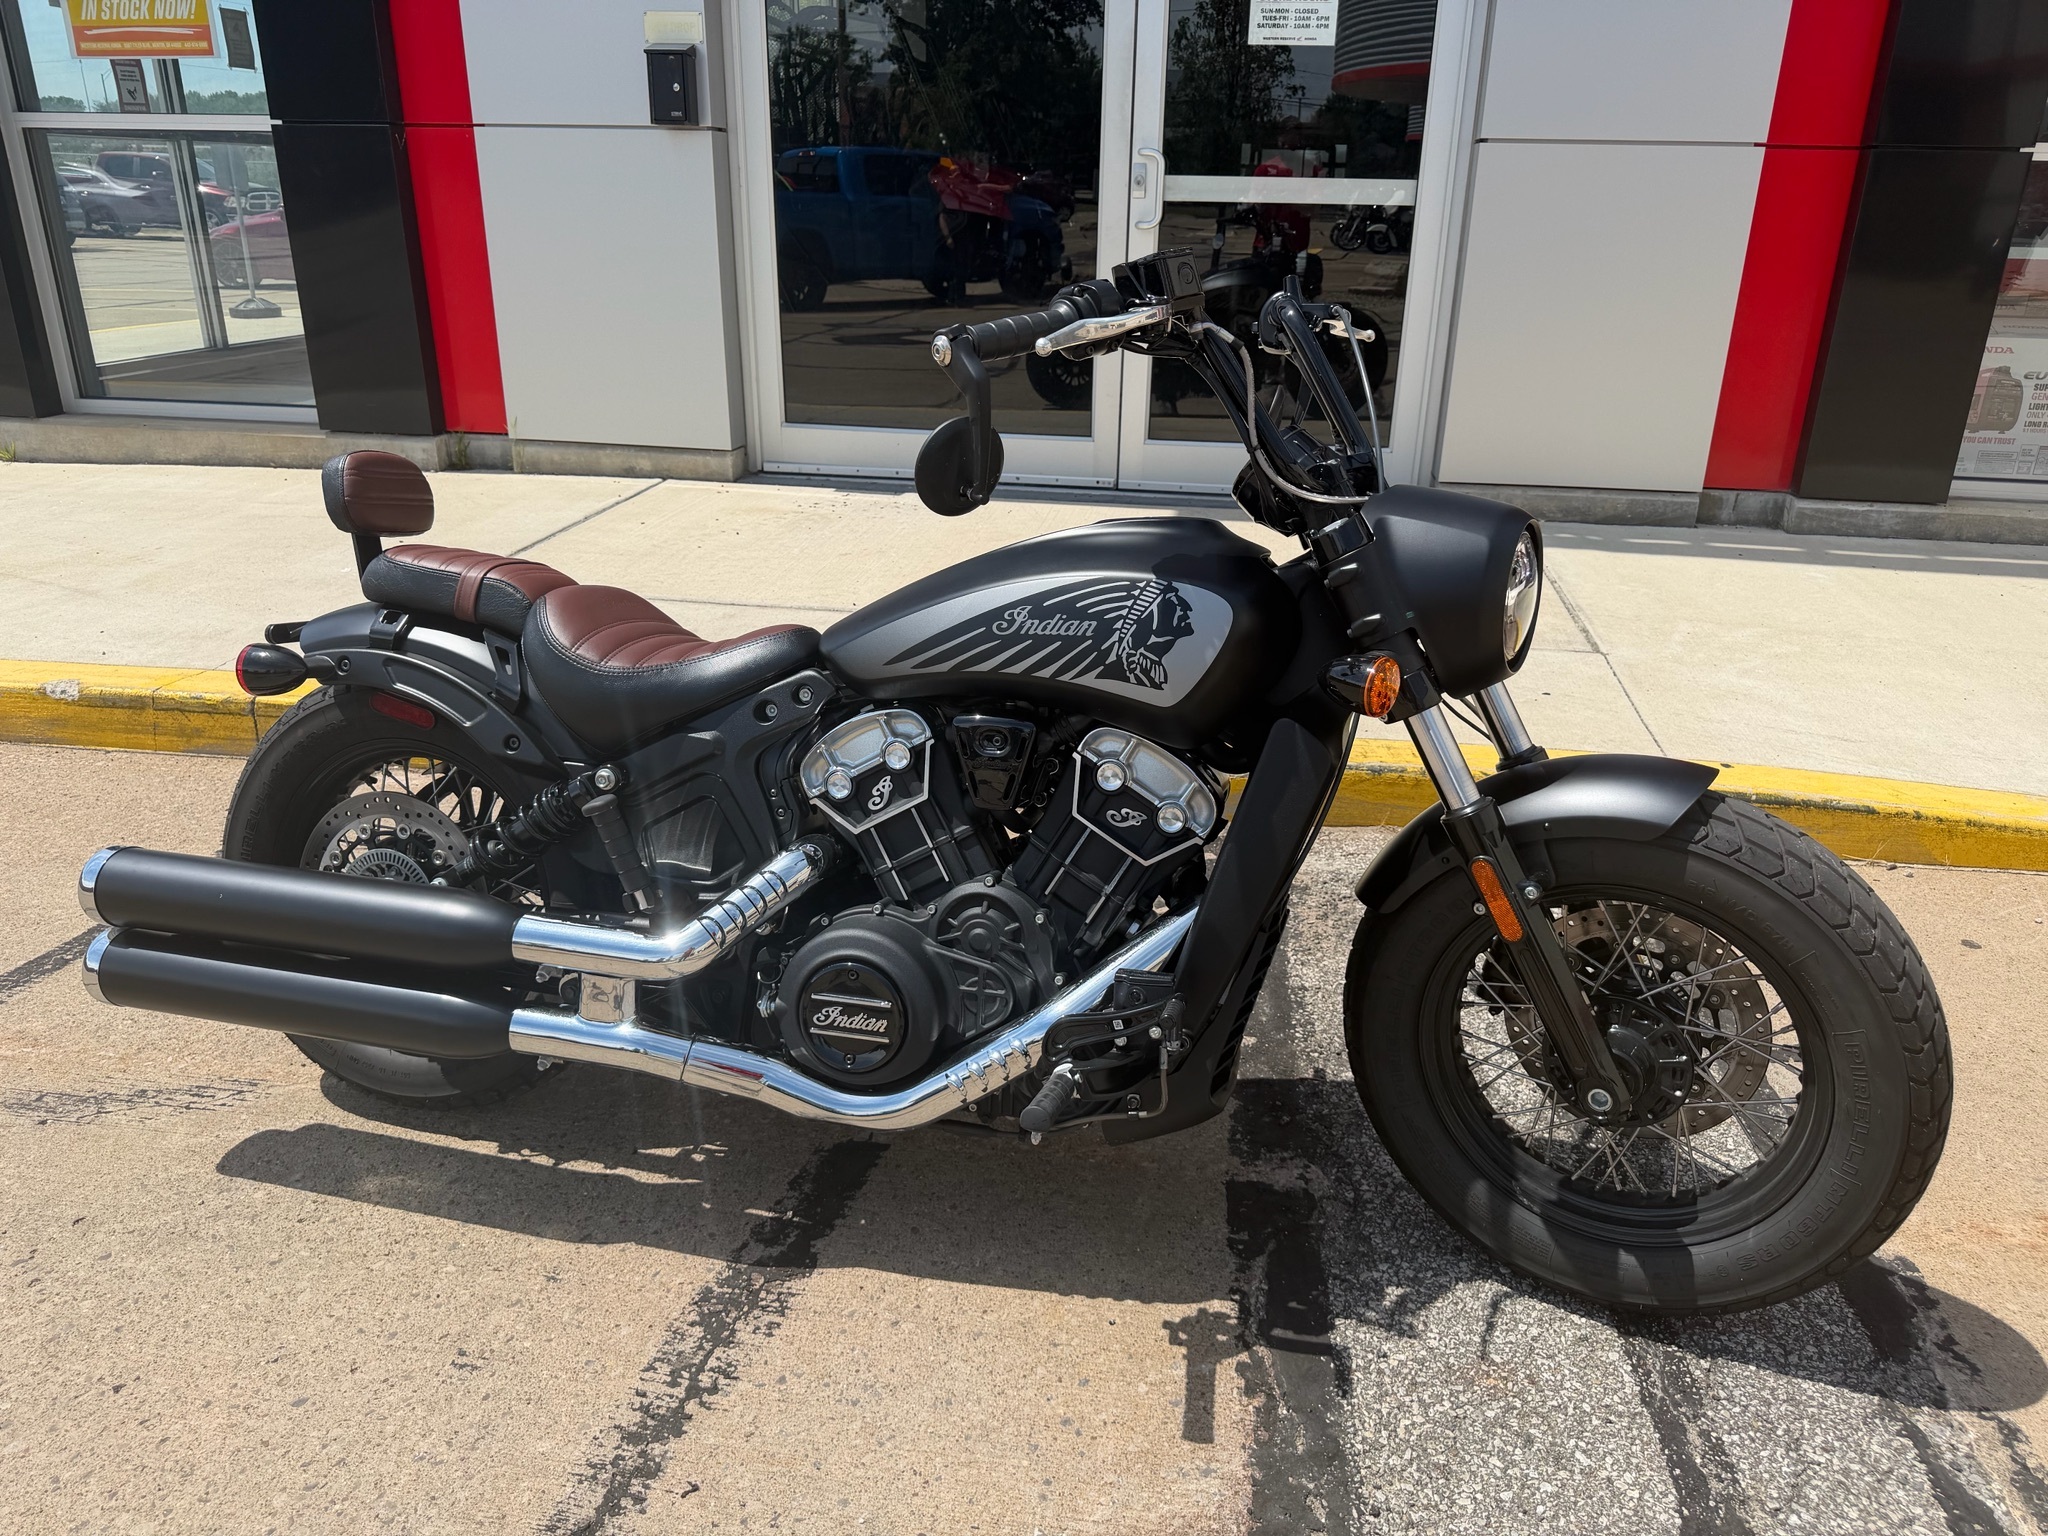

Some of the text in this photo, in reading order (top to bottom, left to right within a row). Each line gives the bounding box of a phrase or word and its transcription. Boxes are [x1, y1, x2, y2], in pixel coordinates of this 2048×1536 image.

[81, 0, 197, 20] IN STOCK NOW!
[2023, 420, 2042, 428] LONG
[2026, 411, 2046, 419] ONLY
[1963, 436, 2016, 445] YOU CAN TRUST
[992, 605, 1098, 637] Indian
[812, 1006, 888, 1033] Indian
[1842, 1041, 1871, 1177] PIRELLI
